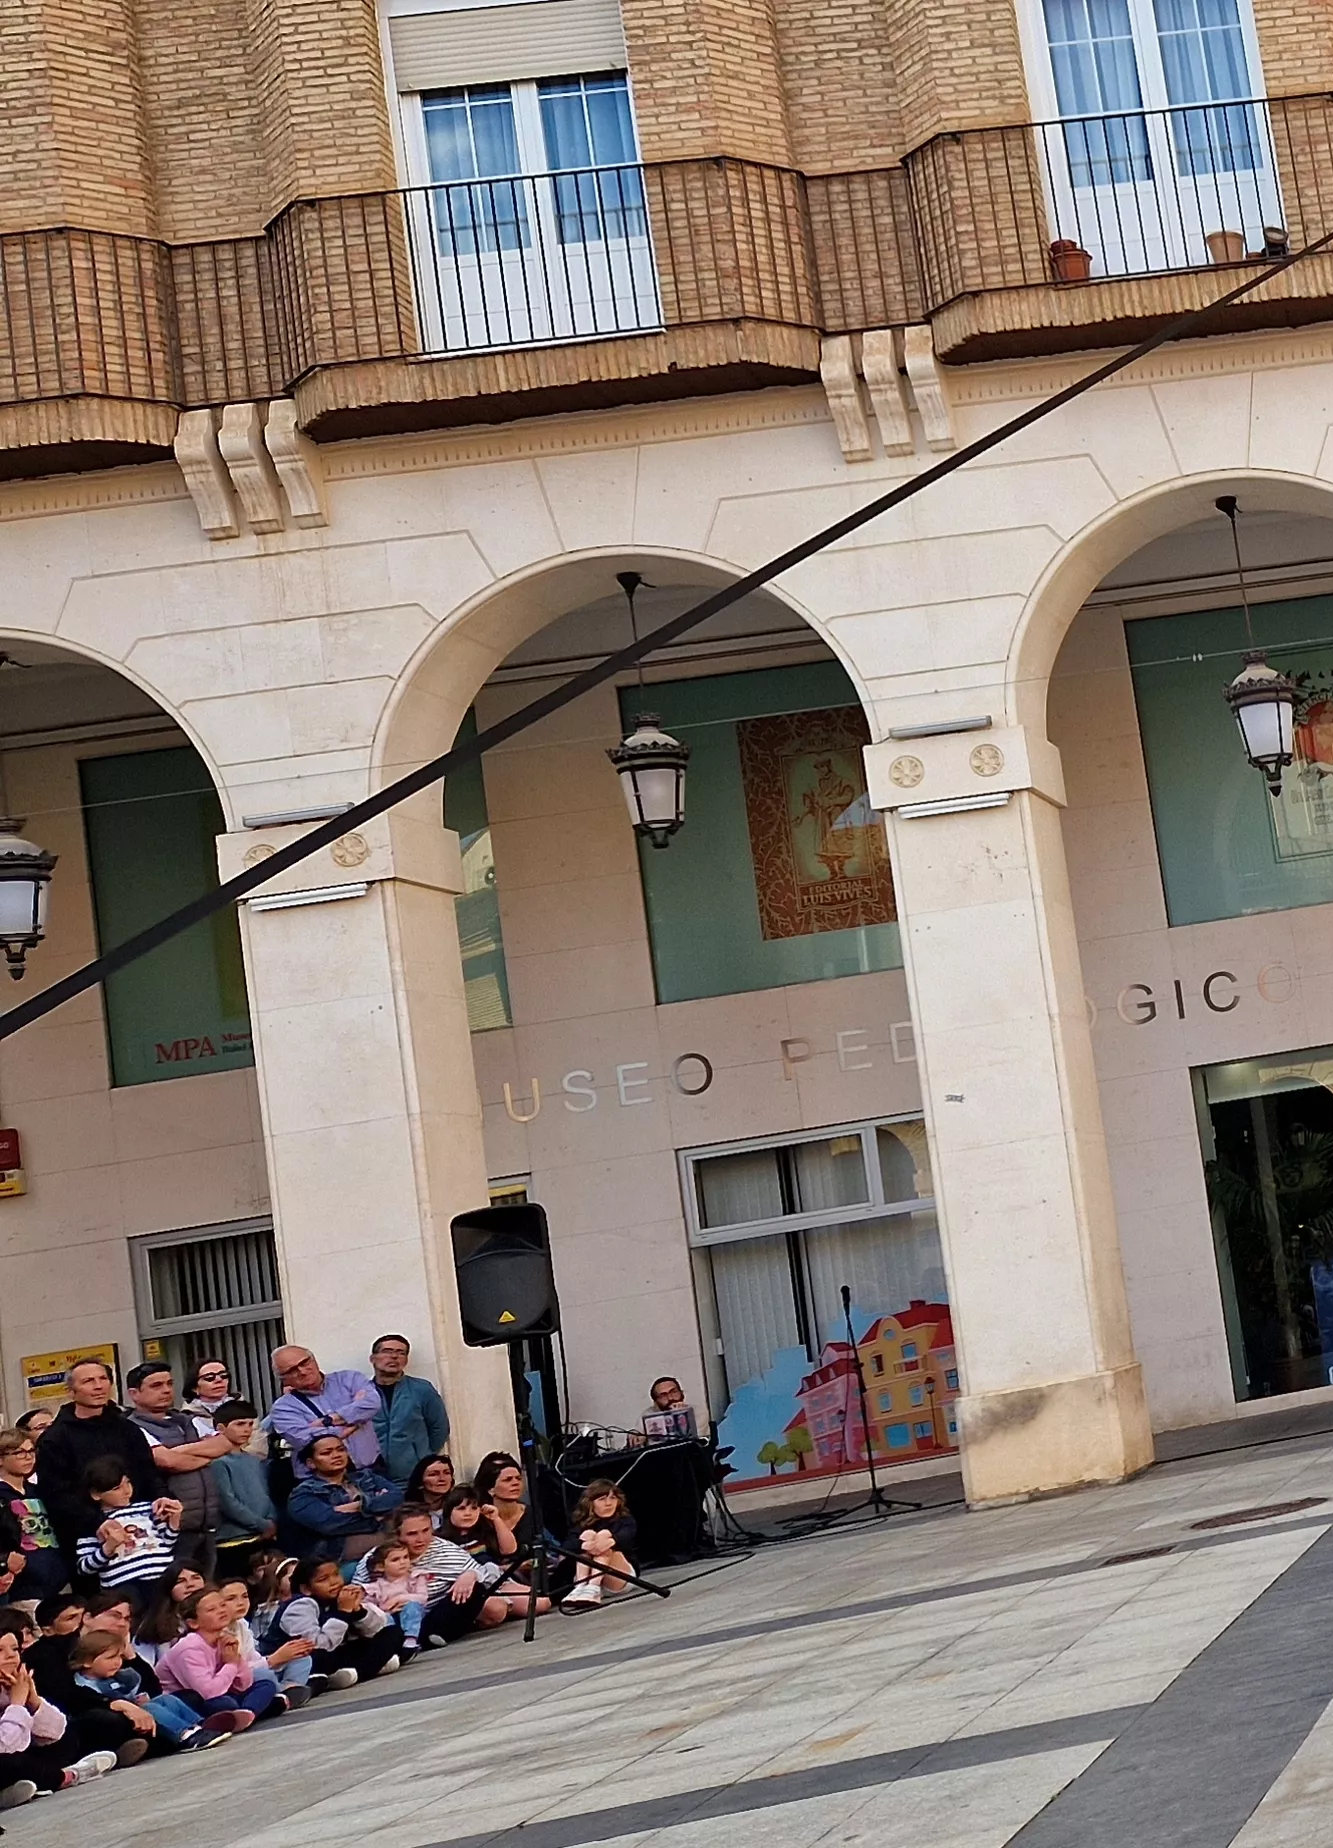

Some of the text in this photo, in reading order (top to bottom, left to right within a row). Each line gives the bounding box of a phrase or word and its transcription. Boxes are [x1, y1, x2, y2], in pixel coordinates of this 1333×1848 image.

[802, 885, 872, 906] LUIS VIVES
[809, 879, 864, 894] EDITORIAL
[154, 1036, 218, 1064] MPA
[502, 1052, 713, 1121] USEO
